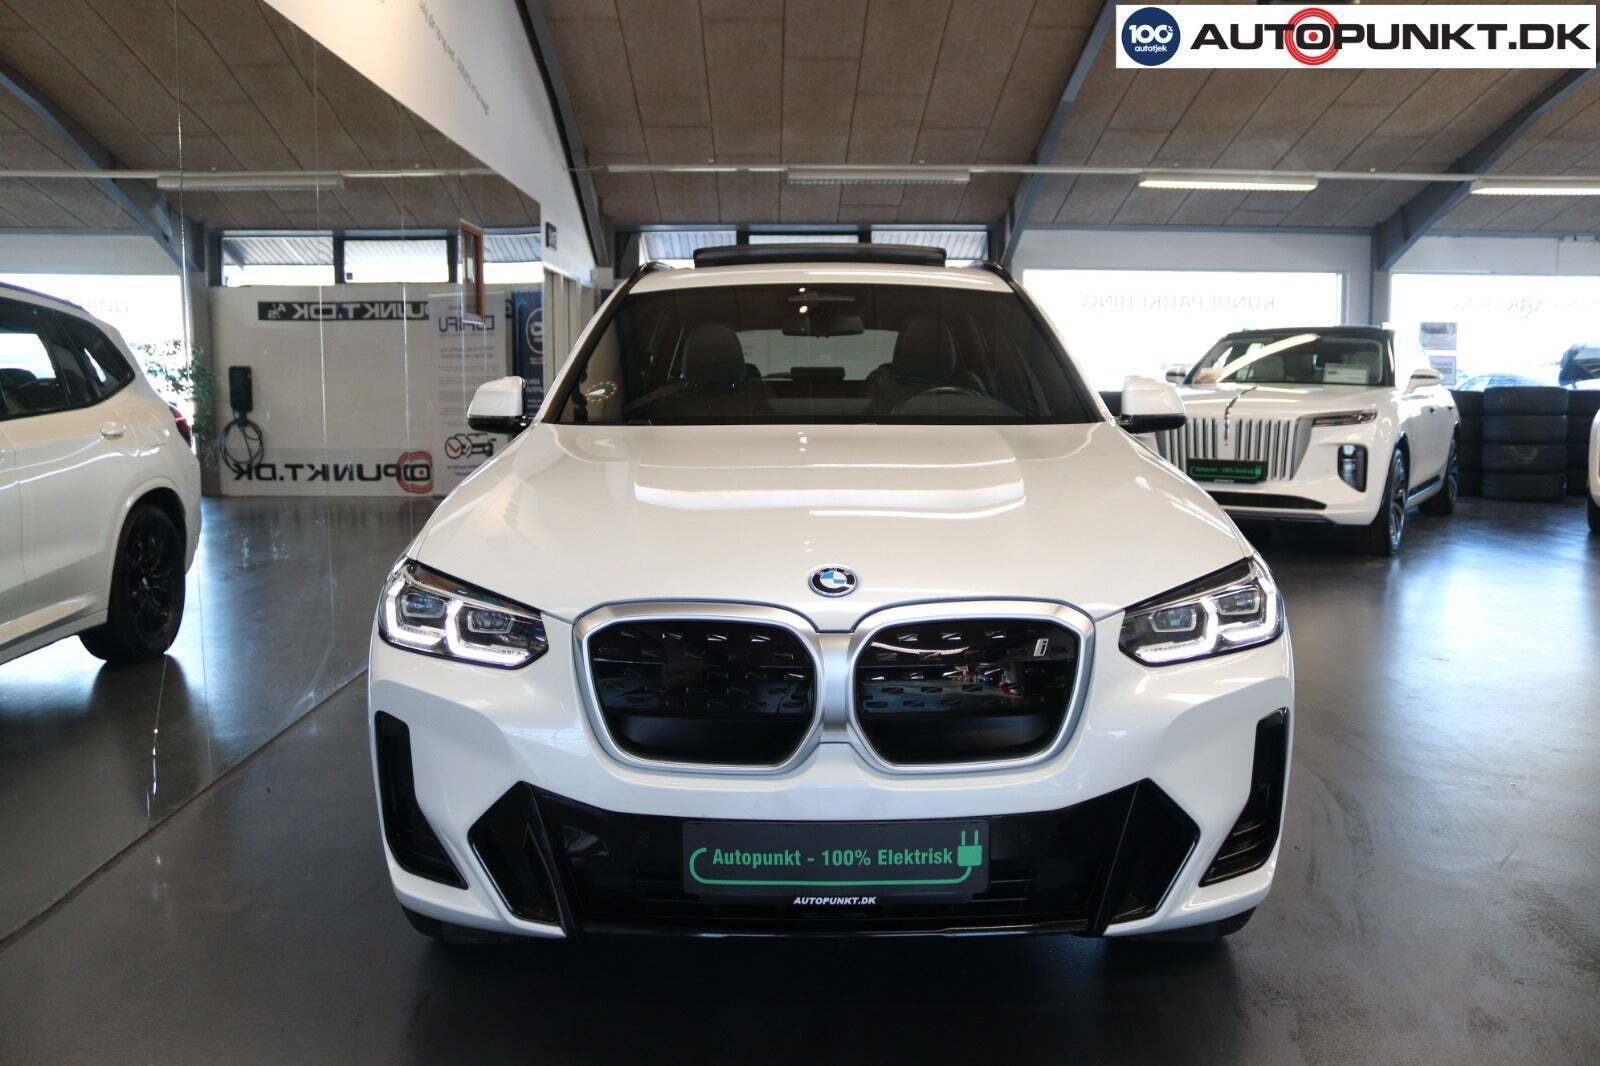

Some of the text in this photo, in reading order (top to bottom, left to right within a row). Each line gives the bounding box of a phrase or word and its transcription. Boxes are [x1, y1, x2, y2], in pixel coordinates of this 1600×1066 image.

[712, 848, 802, 869] Autopunkt
[821, 849, 872, 866] 100%
[877, 848, 953, 866] Elektrisk
[793, 896, 877, 905] AUTOPUNKT.DK
